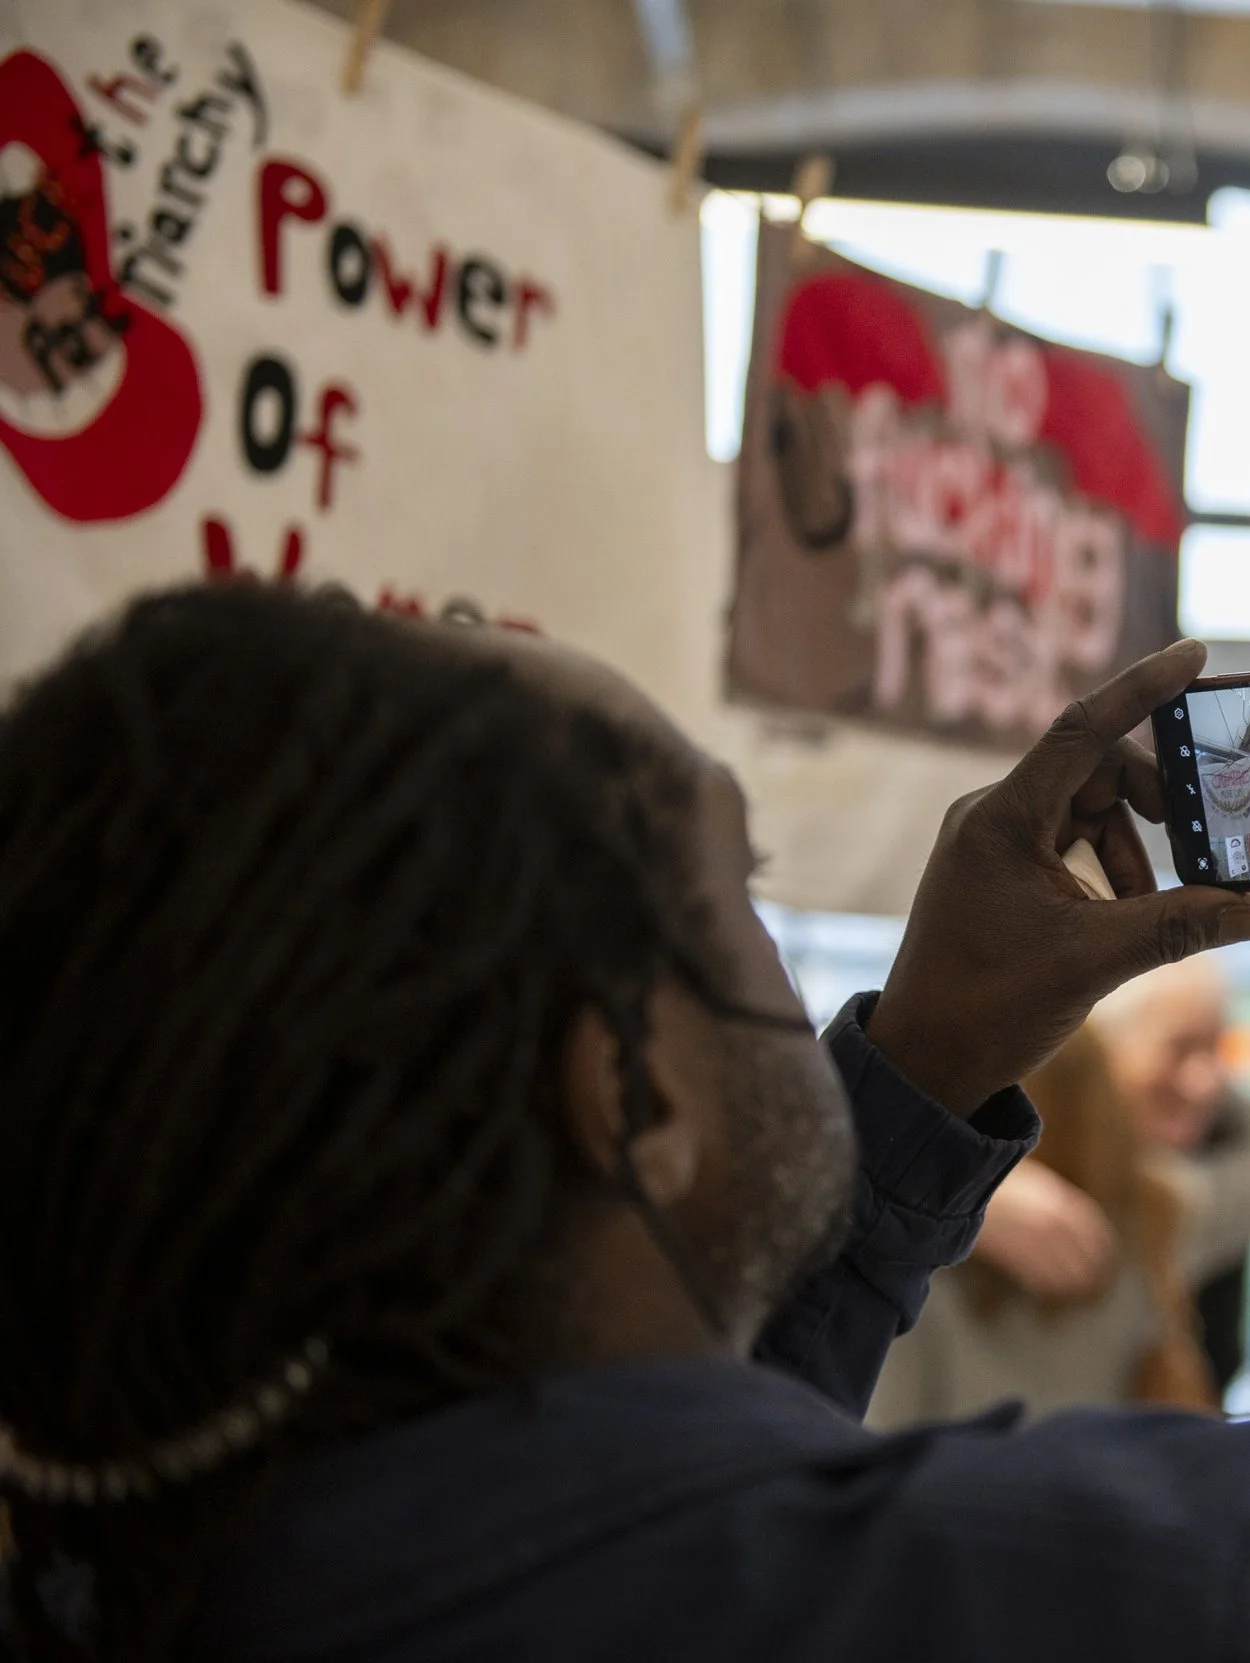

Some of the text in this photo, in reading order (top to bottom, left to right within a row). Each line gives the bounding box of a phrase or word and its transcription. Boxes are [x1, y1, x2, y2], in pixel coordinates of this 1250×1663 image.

[68, 32, 180, 170] the
[255, 155, 558, 352] Power
[238, 350, 360, 515] Of
